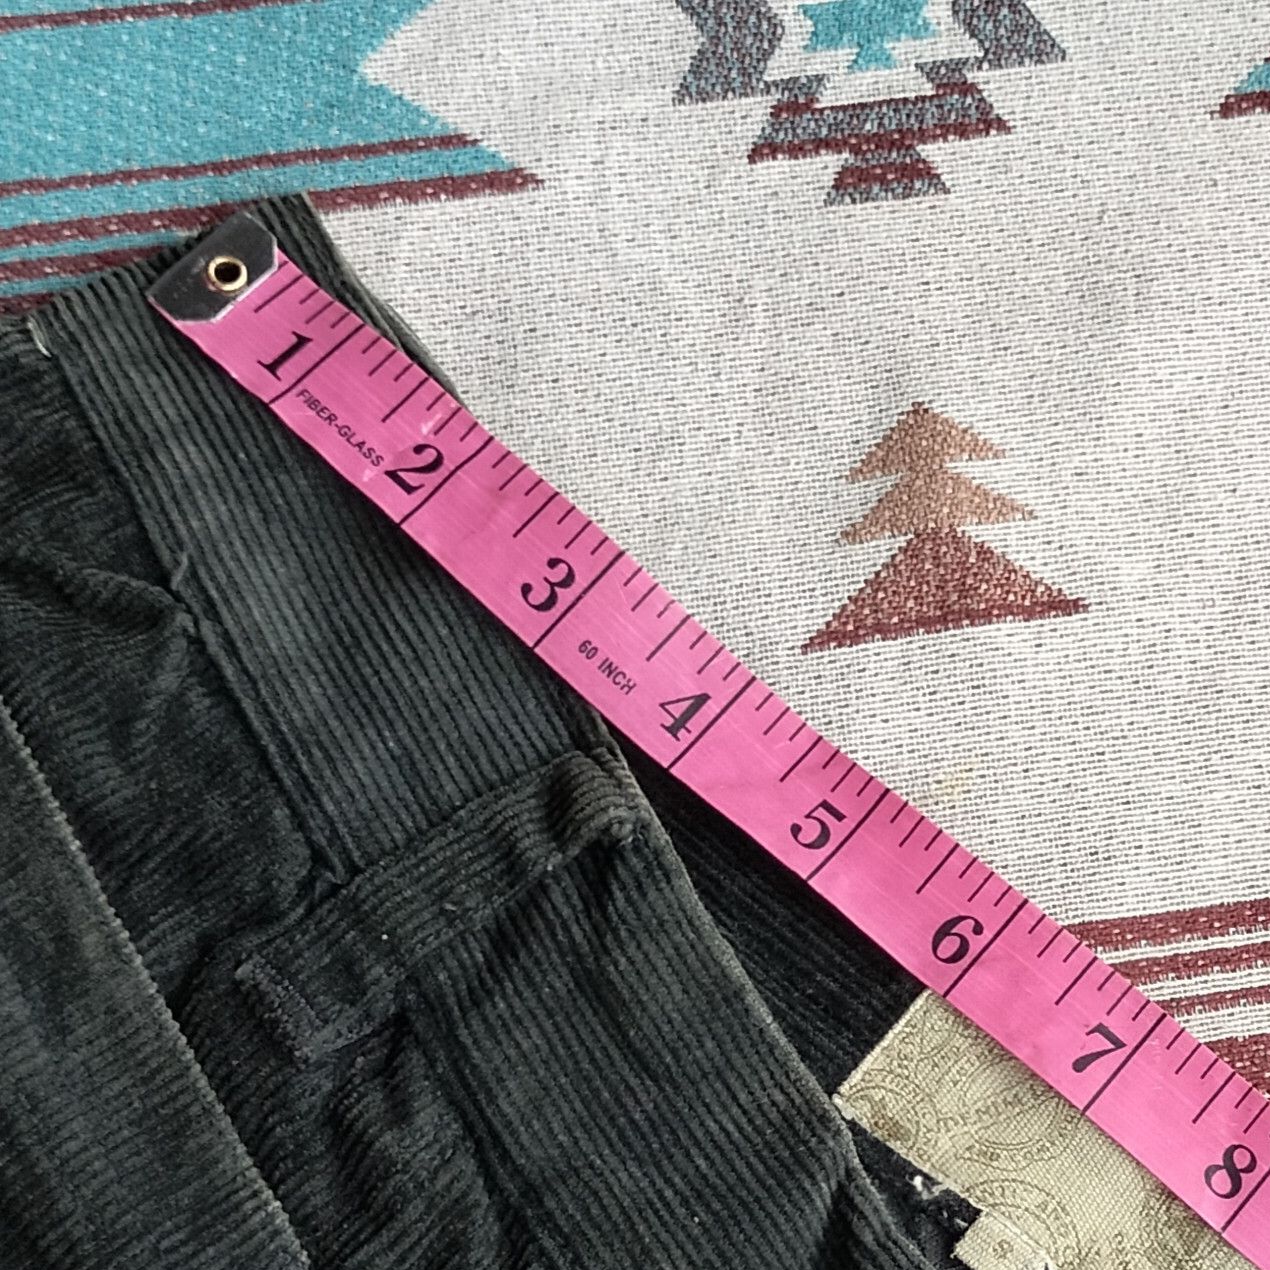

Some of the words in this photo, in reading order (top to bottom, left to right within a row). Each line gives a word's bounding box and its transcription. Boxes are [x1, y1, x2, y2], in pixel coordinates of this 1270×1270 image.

[256, 330, 314, 382] 1
[297, 387, 385, 468] FIBER-GLASS
[382, 442, 445, 495] 2
[520, 557, 576, 614] 3
[577, 639, 599, 661] 60
[597, 656, 637, 696] INCH
[658, 691, 712, 743] 4
[788, 798, 847, 851] 5
[930, 914, 984, 965] 6
[1071, 1022, 1127, 1074] 7
[1203, 1143, 1258, 1200] 8
